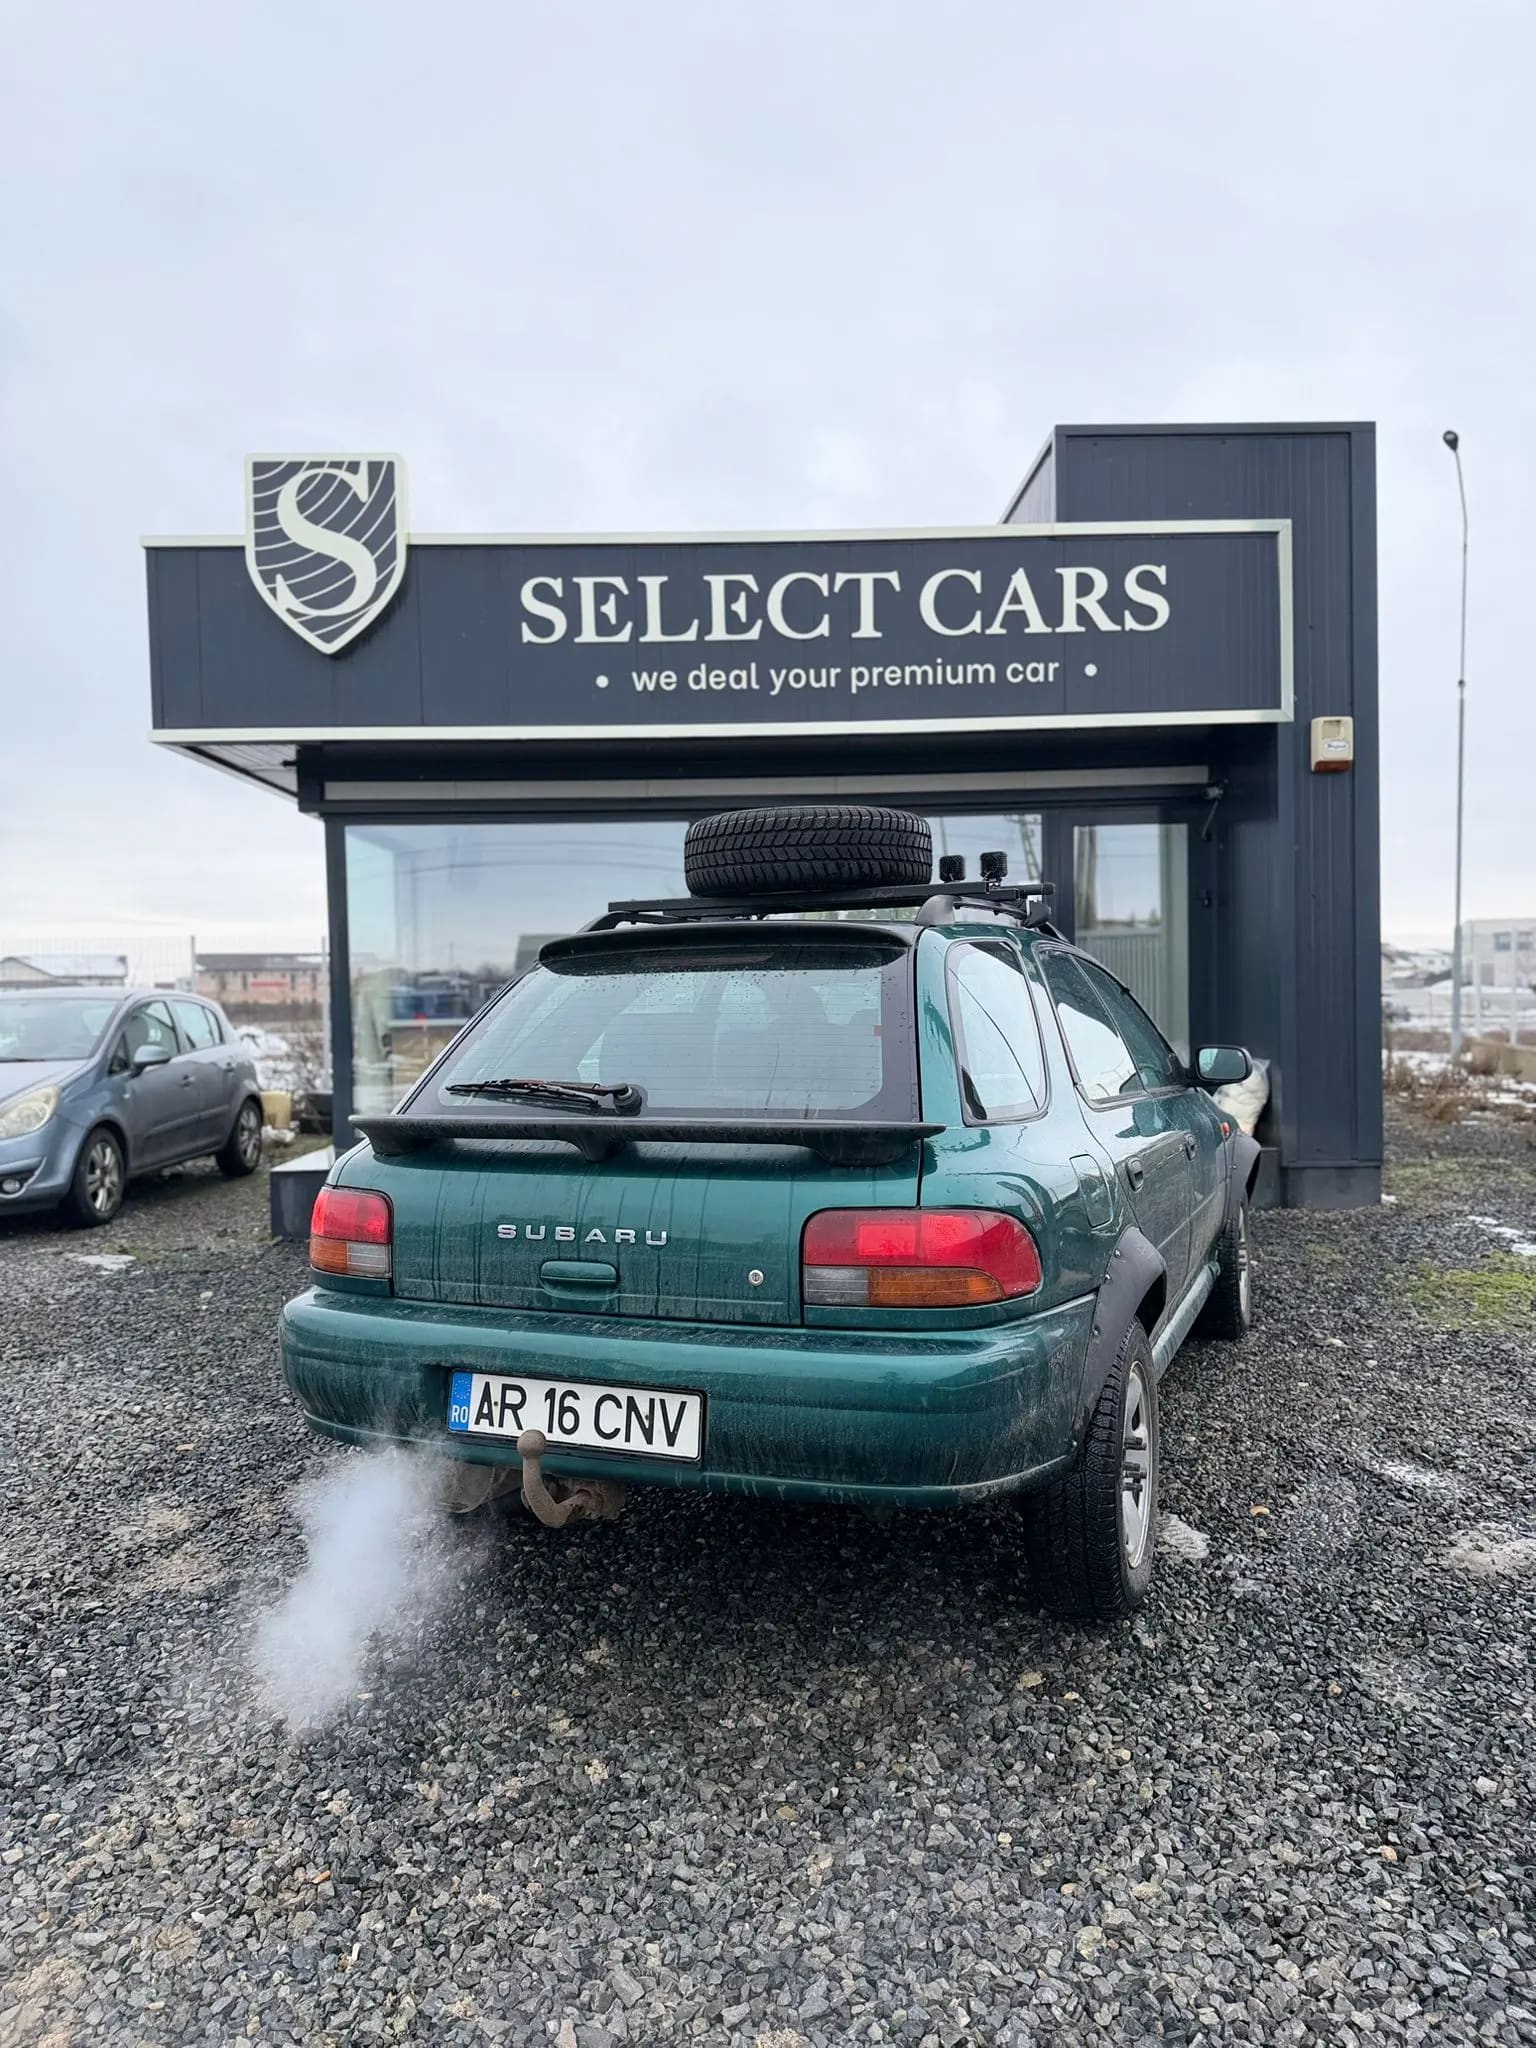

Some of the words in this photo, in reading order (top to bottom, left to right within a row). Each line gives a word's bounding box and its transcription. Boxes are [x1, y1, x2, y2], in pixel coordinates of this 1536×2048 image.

[276, 461, 377, 616] S
[520, 570, 901, 644] SELECT
[919, 564, 1170, 636] CARS
[631, 670, 678, 692] we
[687, 662, 760, 691] deal
[769, 667, 842, 696] your
[850, 663, 996, 694] premium
[1005, 661, 1060, 684] car
[497, 1224, 667, 1246] SUBARU
[450, 1404, 469, 1424] RO
[474, 1381, 527, 1431] AR
[544, 1387, 581, 1436] 16
[593, 1393, 688, 1448] CNV
